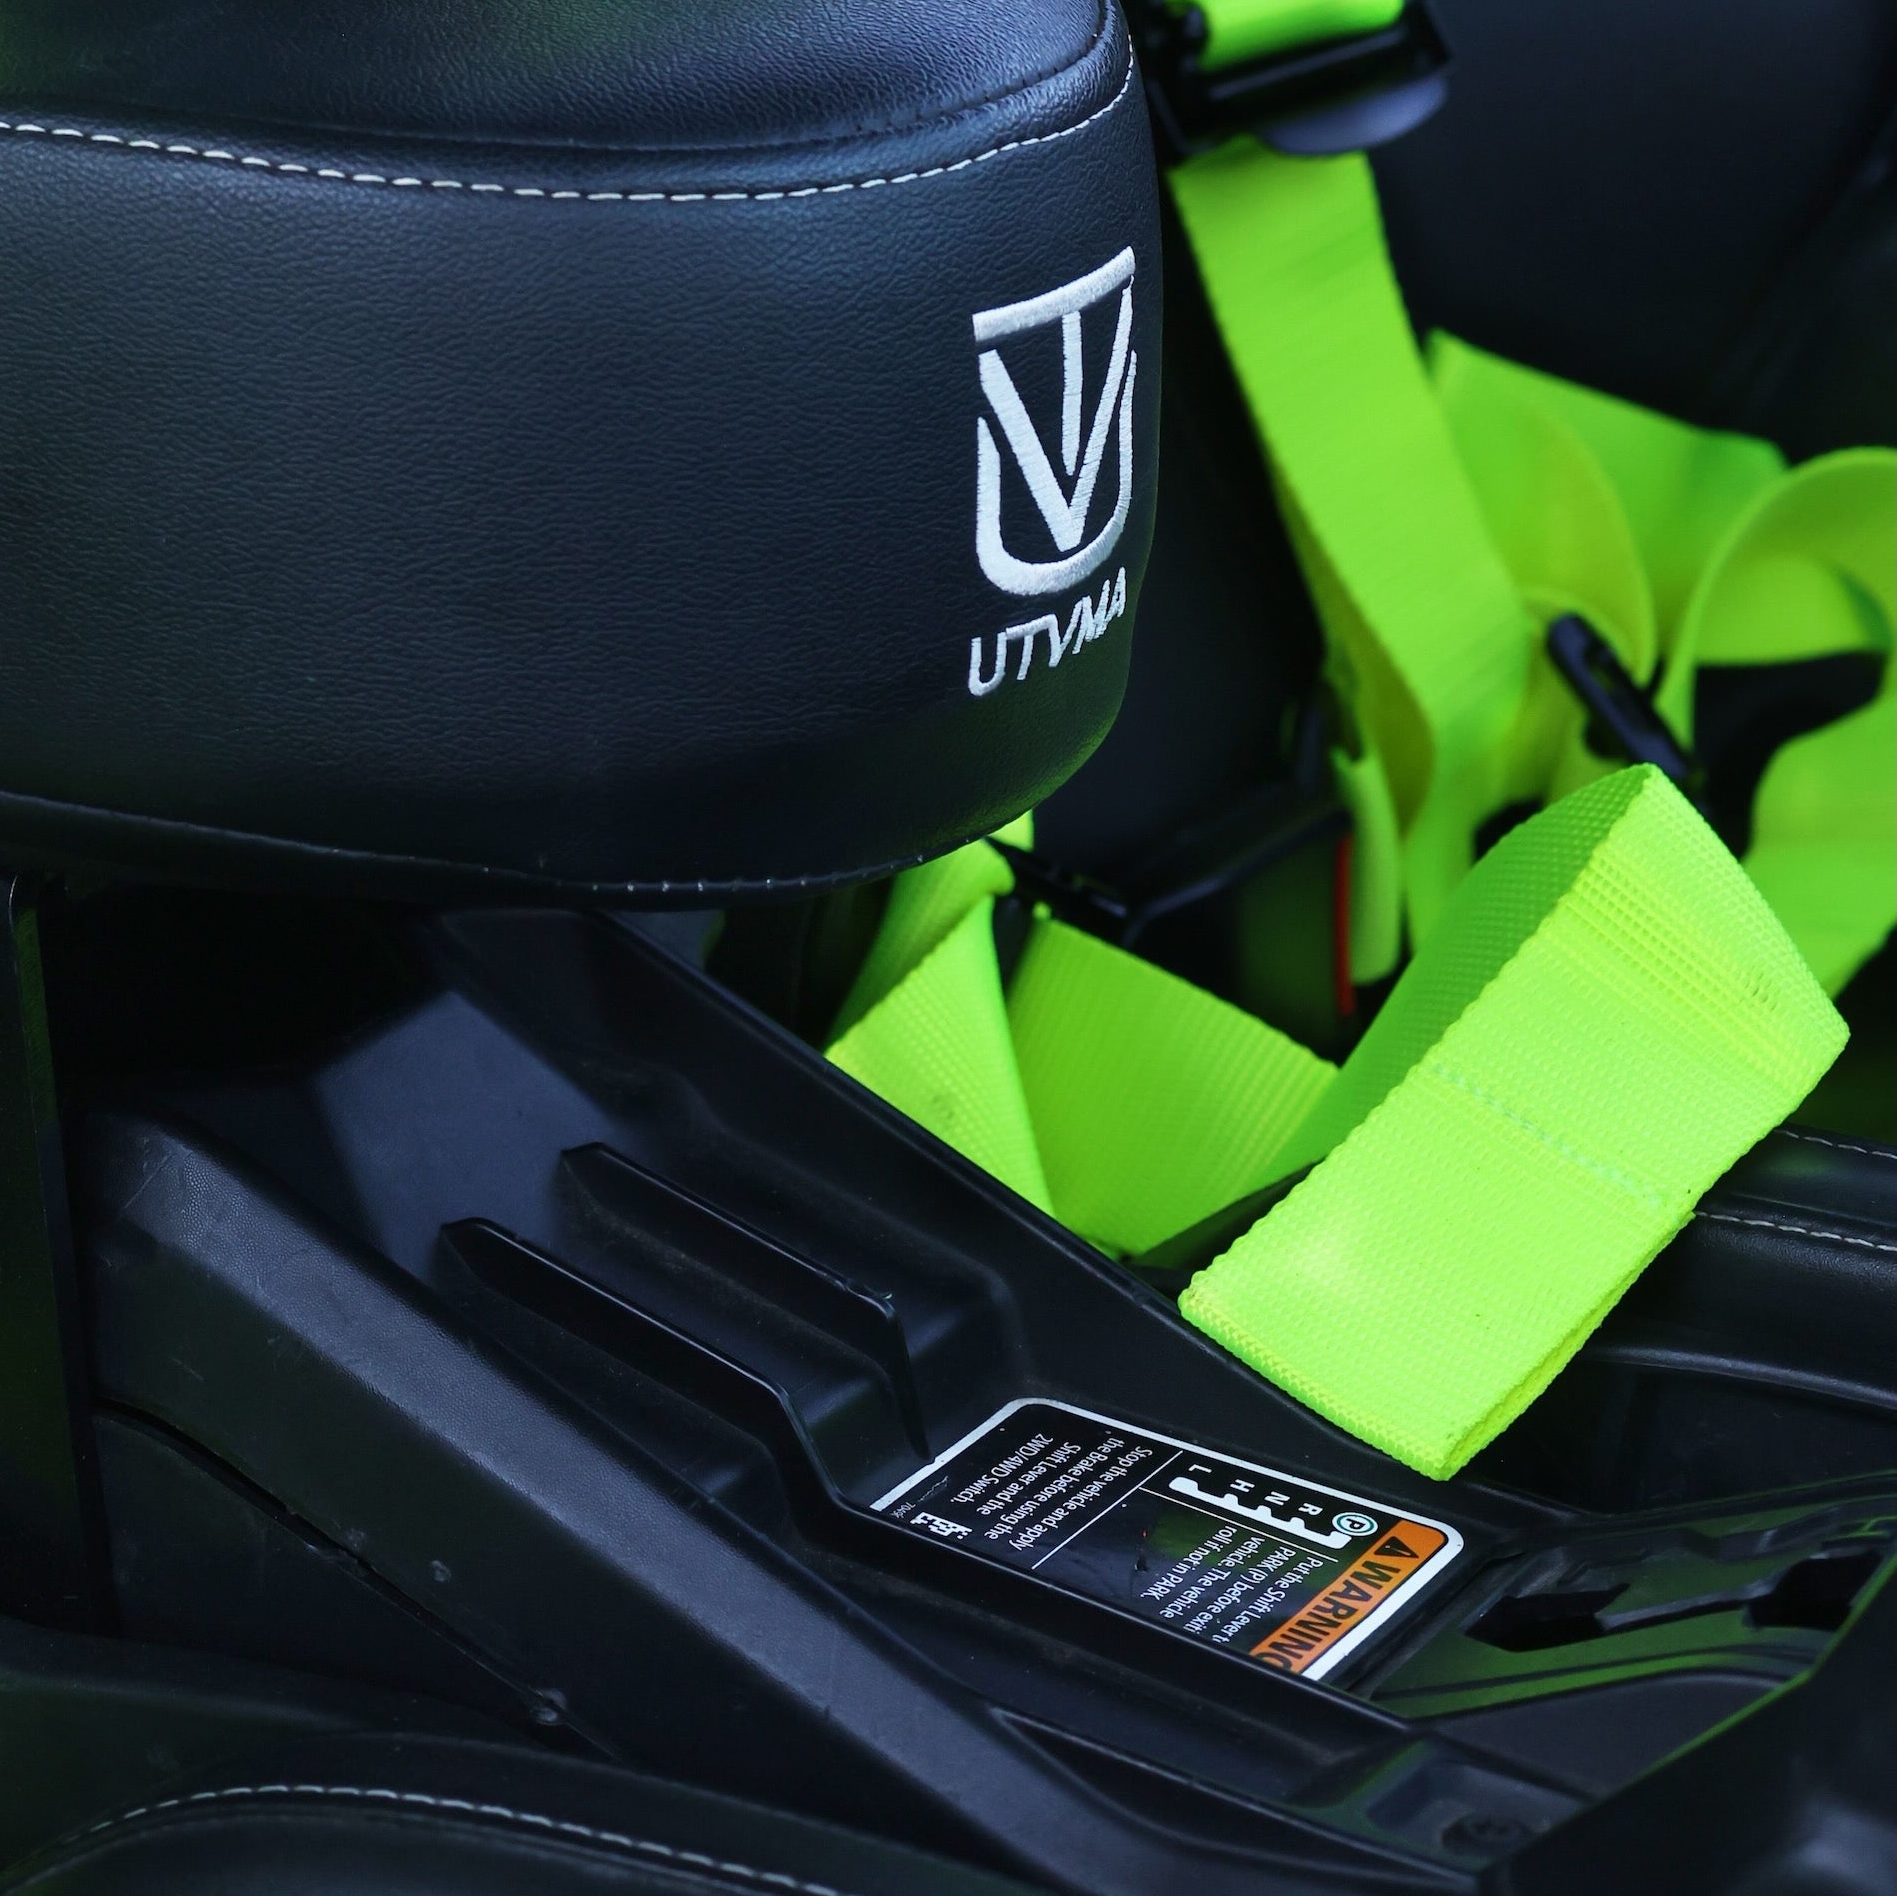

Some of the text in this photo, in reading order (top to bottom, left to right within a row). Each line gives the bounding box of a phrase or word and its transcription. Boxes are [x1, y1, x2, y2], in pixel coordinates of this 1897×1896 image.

[968, 567, 1127, 697] UTVMA
[950, 1433, 1053, 1502] 2WD/4WD Switch.
[976, 1442, 1081, 1515] Shift Lever and the
[1188, 1464, 1212, 1473] L
[984, 1438, 1125, 1539] the Brake before using the
[1009, 1446, 1153, 1551] Stop the vehicle and apply
[1230, 1479, 1255, 1492] H
[1264, 1491, 1290, 1506] N
[1298, 1503, 1323, 1515] R
[1345, 1518, 1366, 1530] P
[1140, 1526, 1237, 1600] roll if not in PARK.
[1256, 1546, 1296, 1572] PARK
[1293, 1557, 1323, 1575] Put
[1159, 1537, 1265, 1618] vehicle. The vehicle
[1240, 1568, 1268, 1584] (P)
[1274, 1572, 1304, 1588] the
[1207, 1581, 1254, 1613] before
[1248, 1587, 1286, 1613] Shift
[1221, 1610, 1260, 1637] Lever
